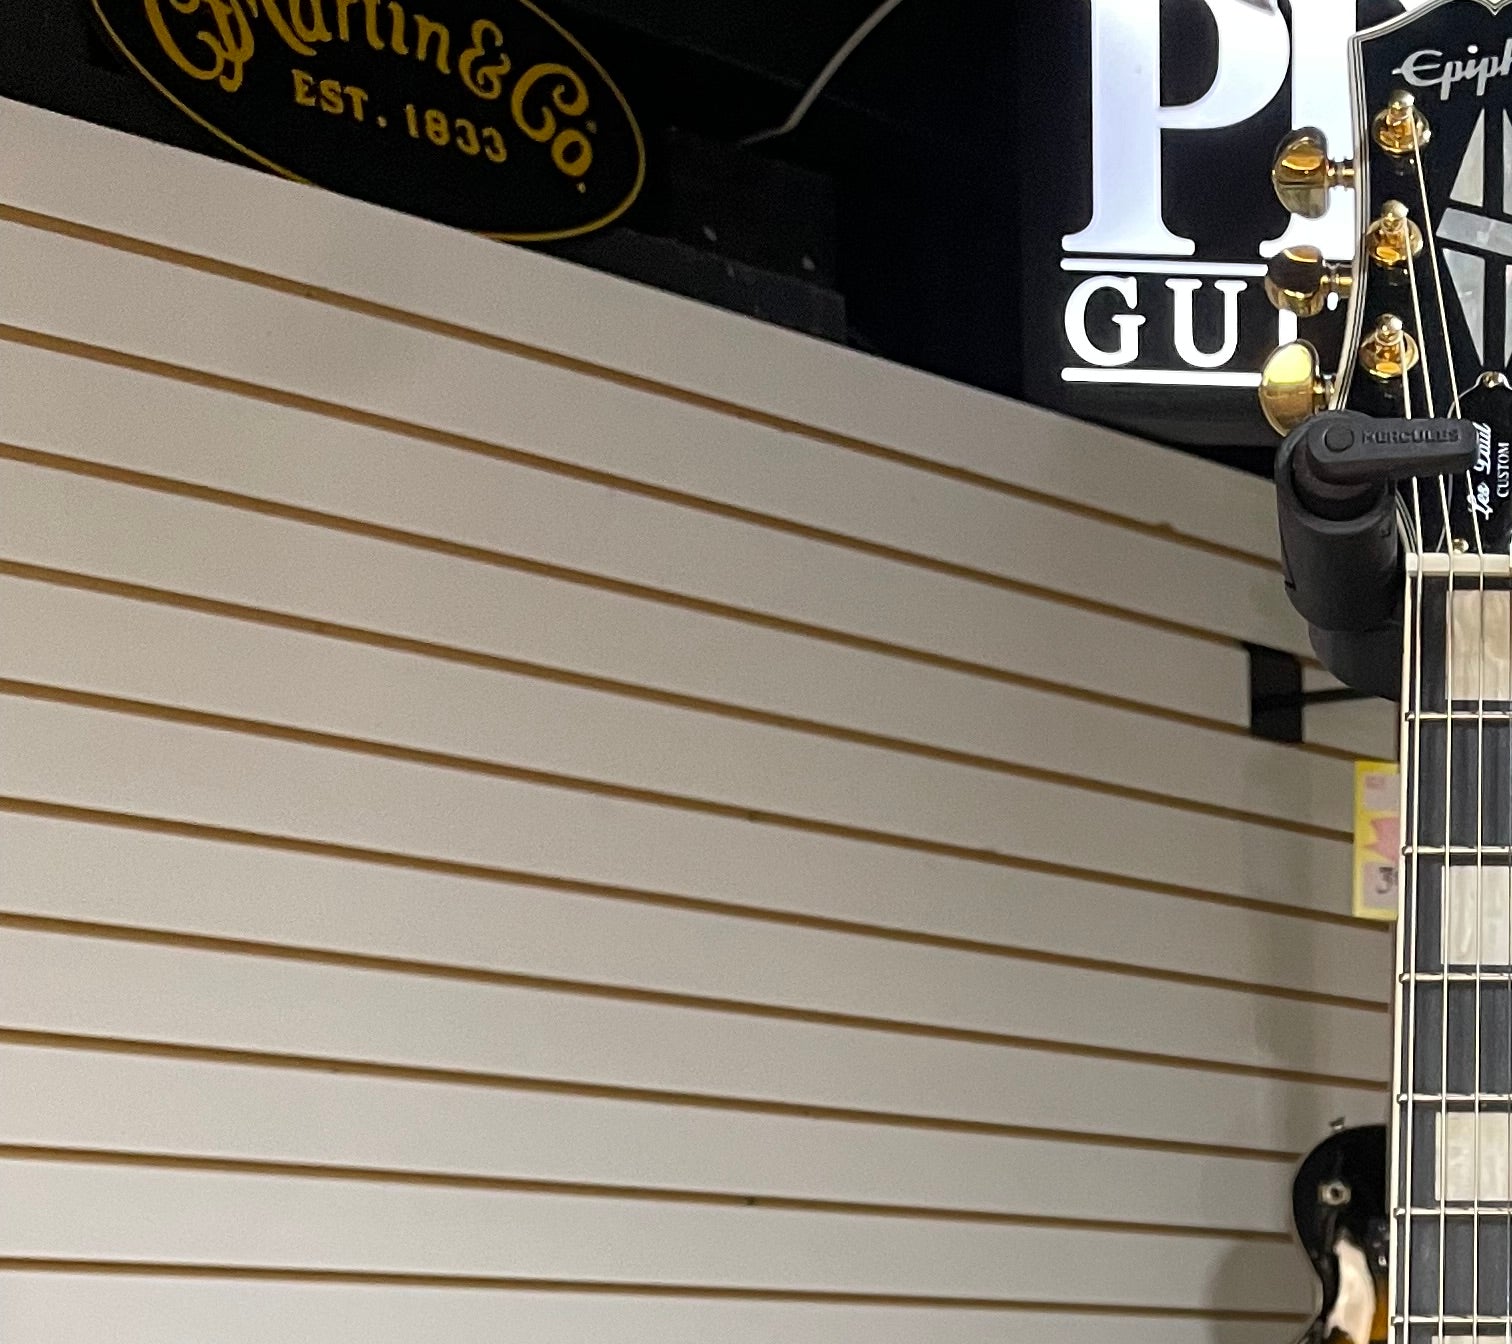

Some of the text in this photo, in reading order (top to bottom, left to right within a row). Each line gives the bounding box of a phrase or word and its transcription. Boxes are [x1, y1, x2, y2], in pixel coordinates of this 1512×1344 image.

[292, 69, 508, 163] EST. 1833
[1362, 429, 1459, 445] HERCULES
[1496, 441, 1511, 499] CUSTOM
